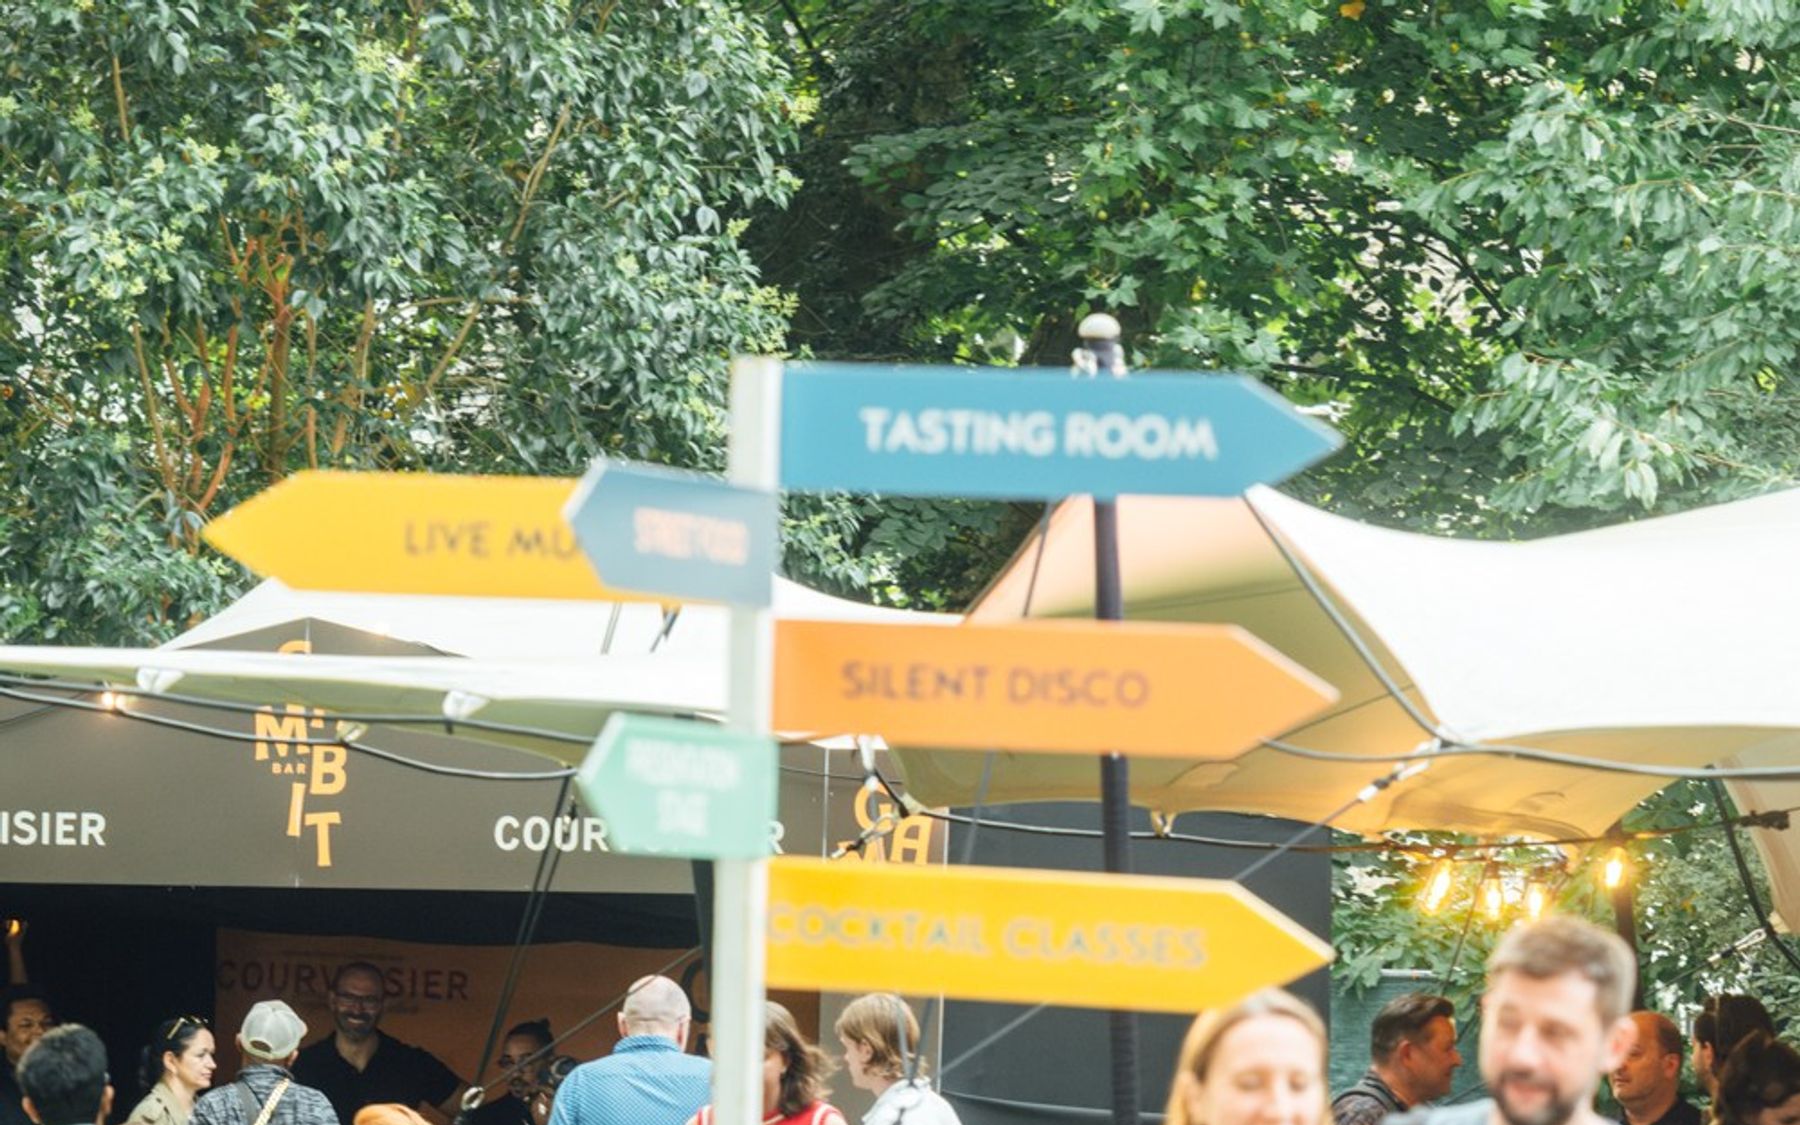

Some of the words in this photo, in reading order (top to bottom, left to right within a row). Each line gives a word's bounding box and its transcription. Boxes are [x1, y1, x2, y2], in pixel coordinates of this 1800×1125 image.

[860, 406, 1056, 456] TASTING
[1064, 411, 1219, 460] ROOM
[404, 519, 490, 559] LIVE
[841, 660, 989, 701] SILENT
[1007, 666, 1151, 708] DISCO
[272, 762, 307, 775] BAR
[767, 902, 992, 957] COCKTAIL
[1003, 916, 1207, 968] CLASSES
